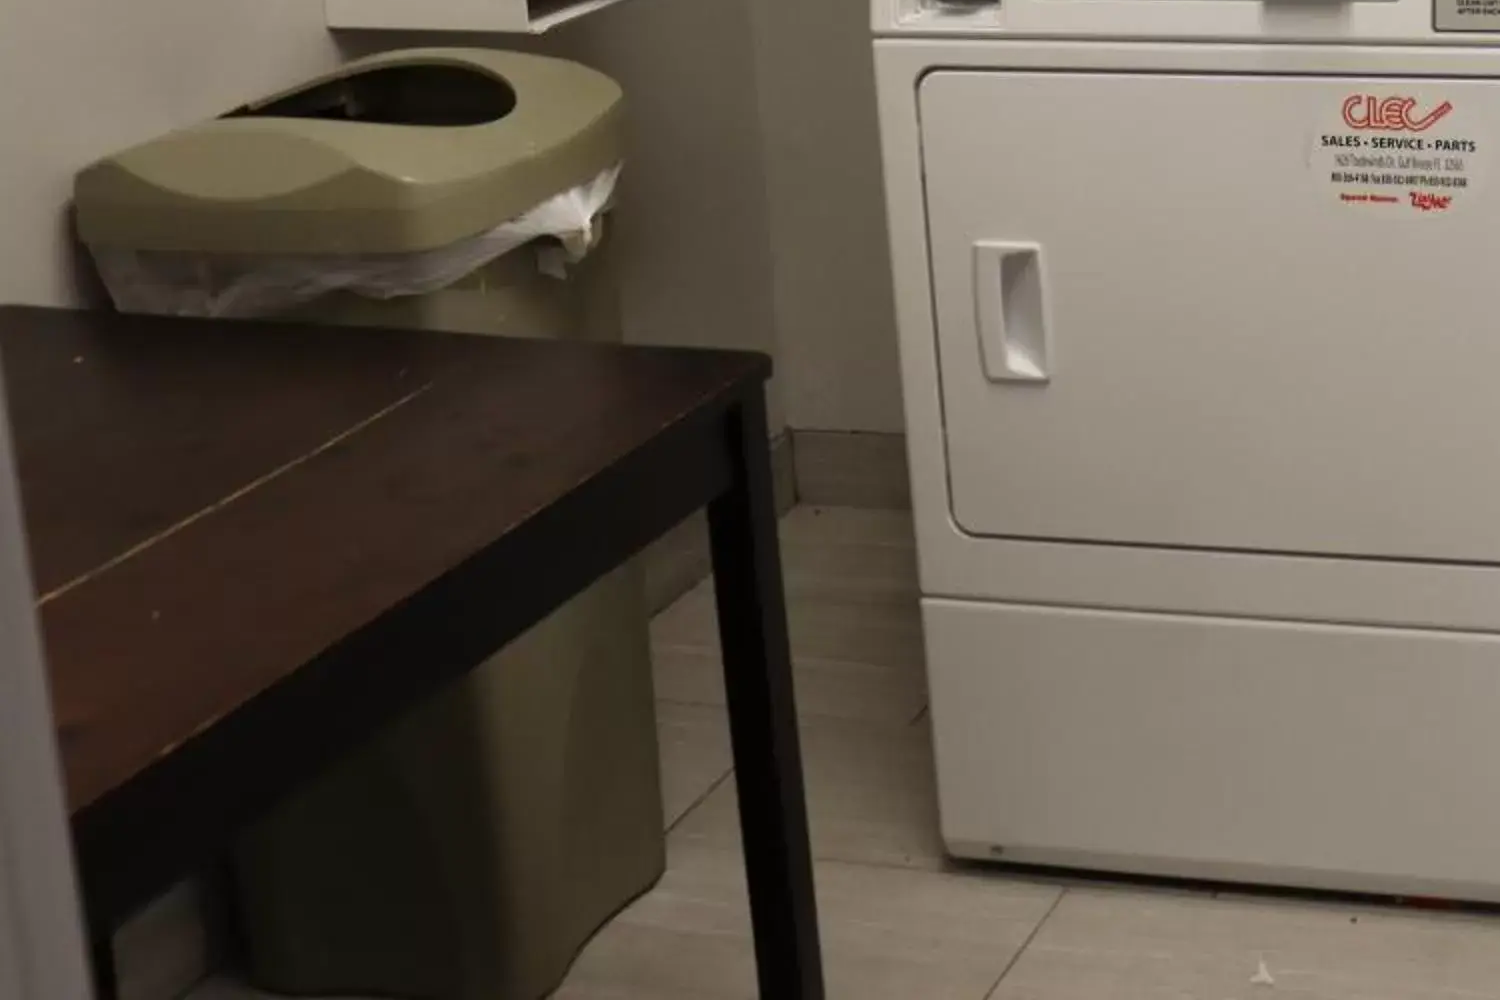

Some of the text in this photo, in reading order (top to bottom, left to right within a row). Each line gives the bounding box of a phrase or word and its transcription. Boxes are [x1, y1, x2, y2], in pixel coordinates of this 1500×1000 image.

[1321, 135, 1476, 153] SALES SERVICE PARTS
